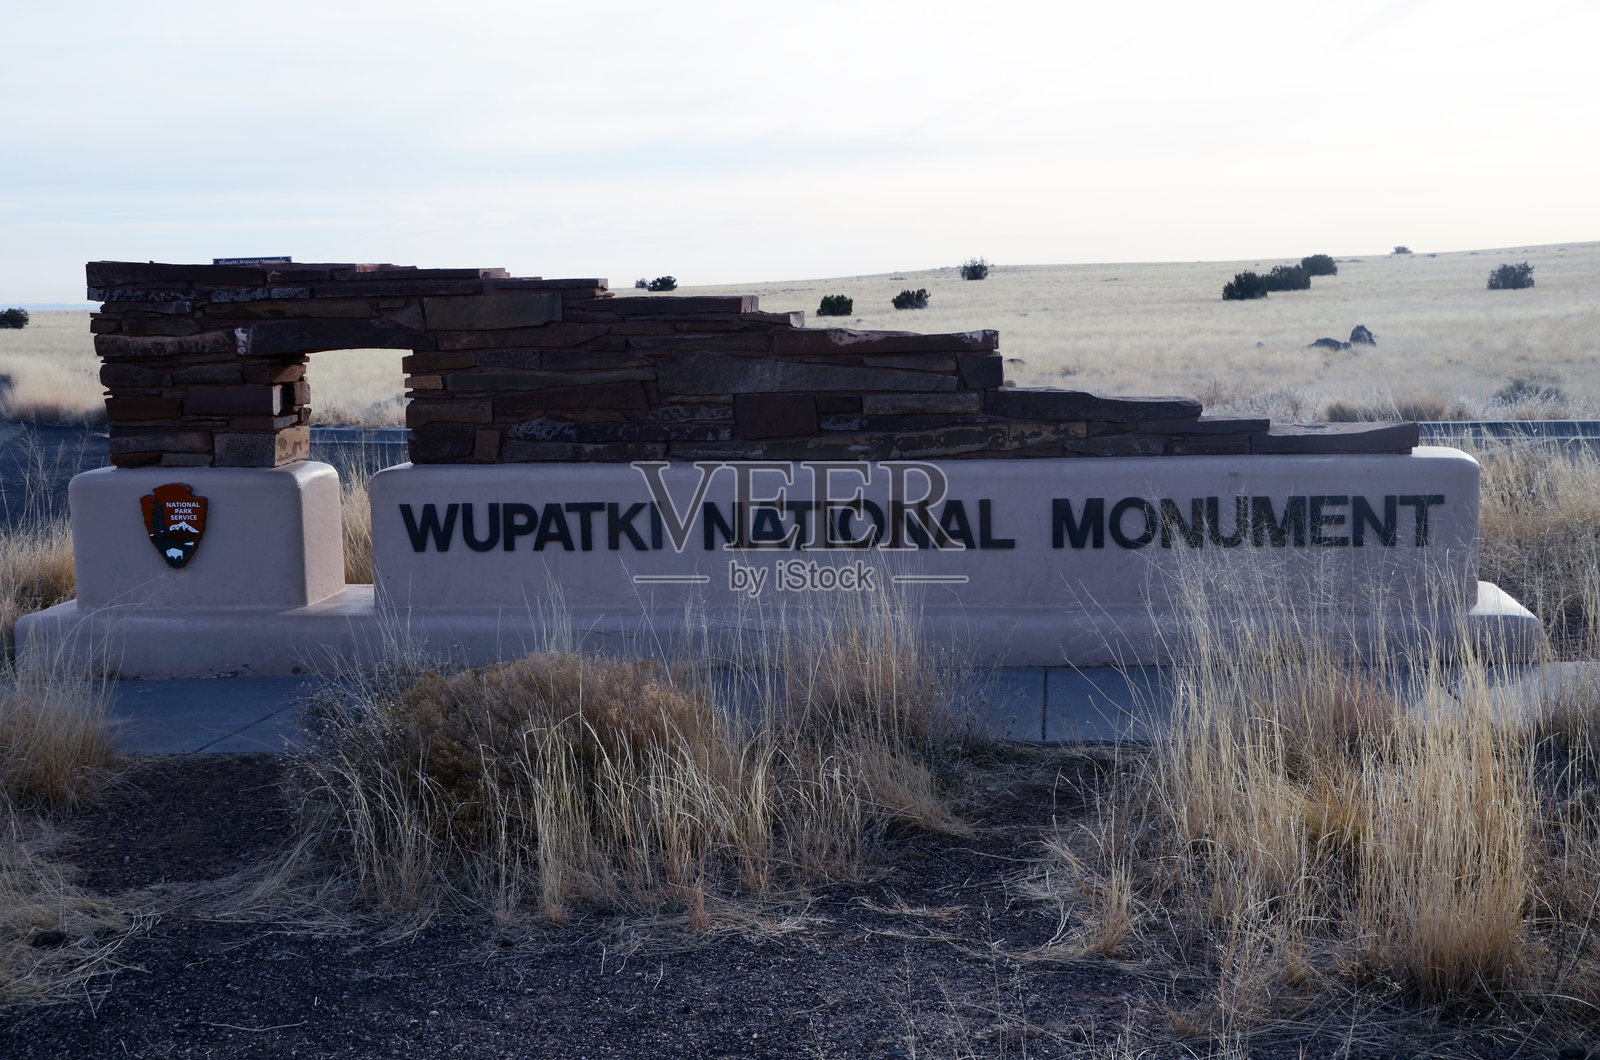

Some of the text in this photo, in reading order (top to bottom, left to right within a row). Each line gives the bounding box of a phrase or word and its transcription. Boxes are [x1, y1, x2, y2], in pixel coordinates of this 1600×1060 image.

[399, 494, 1445, 552] WUPATKI NATIONAL MONUMENT
